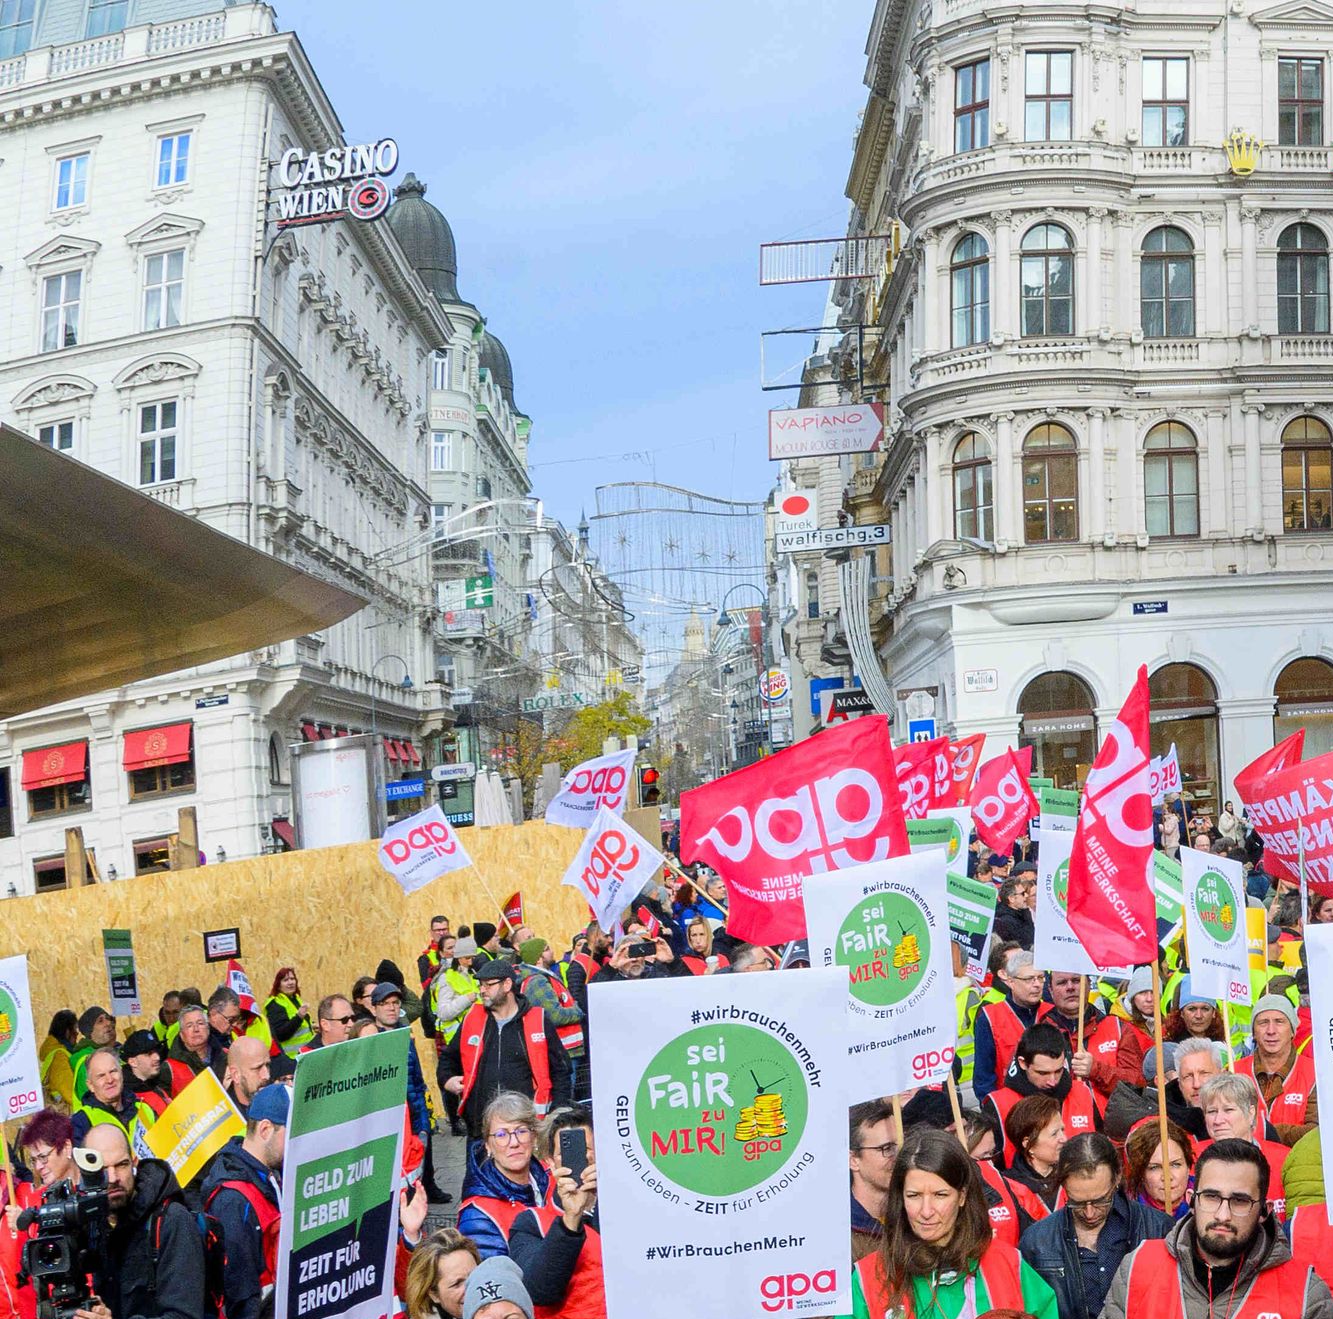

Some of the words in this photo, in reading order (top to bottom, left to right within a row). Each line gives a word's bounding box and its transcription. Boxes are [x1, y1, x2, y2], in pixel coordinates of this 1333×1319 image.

[279, 138, 399, 189] CASINO
[278, 185, 345, 220] WIEN
[779, 519, 813, 531] Turek
[781, 526, 885, 548] walfischg.3
[1032, 724, 1057, 733] ZARA
[1060, 721, 1087, 731] HOME
[861, 899, 884, 922] sei
[863, 879, 937, 929] #wirbrauchenmehr
[840, 923, 892, 957] FaiR
[873, 948, 888, 960] zu
[898, 962, 920, 981] gpa
[874, 1008, 894, 1020] ZEIT
[686, 1037, 727, 1066] sei
[691, 1004, 822, 1090] #wirbrauchenmehr
[847, 1024, 937, 1056] #WirBrauchenMehr
[911, 1046, 955, 1081] gpa
[304, 1064, 399, 1103] #WirBrauchenMehr
[647, 1071, 735, 1111] FaiR
[9, 1090, 37, 1113] gpa
[702, 1108, 726, 1125] zu
[616, 1094, 631, 1139] GELD
[639, 1170, 681, 1207] Leben
[693, 1200, 729, 1216] ZEIT
[731, 1195, 754, 1214] für
[756, 1150, 815, 1206] Erholung
[651, 1127, 727, 1159] MIR!
[743, 1137, 783, 1162] gpa
[302, 1168, 344, 1199] GELD
[347, 1156, 375, 1185] ZUM
[300, 1196, 350, 1233] LEBEN
[299, 1253, 333, 1284] ZEIT
[335, 1239, 360, 1271] FÜR
[645, 1233, 807, 1262] #WirBrauchenMehr
[298, 1264, 375, 1316] ERHOLUNG
[760, 1268, 838, 1313] gpa
